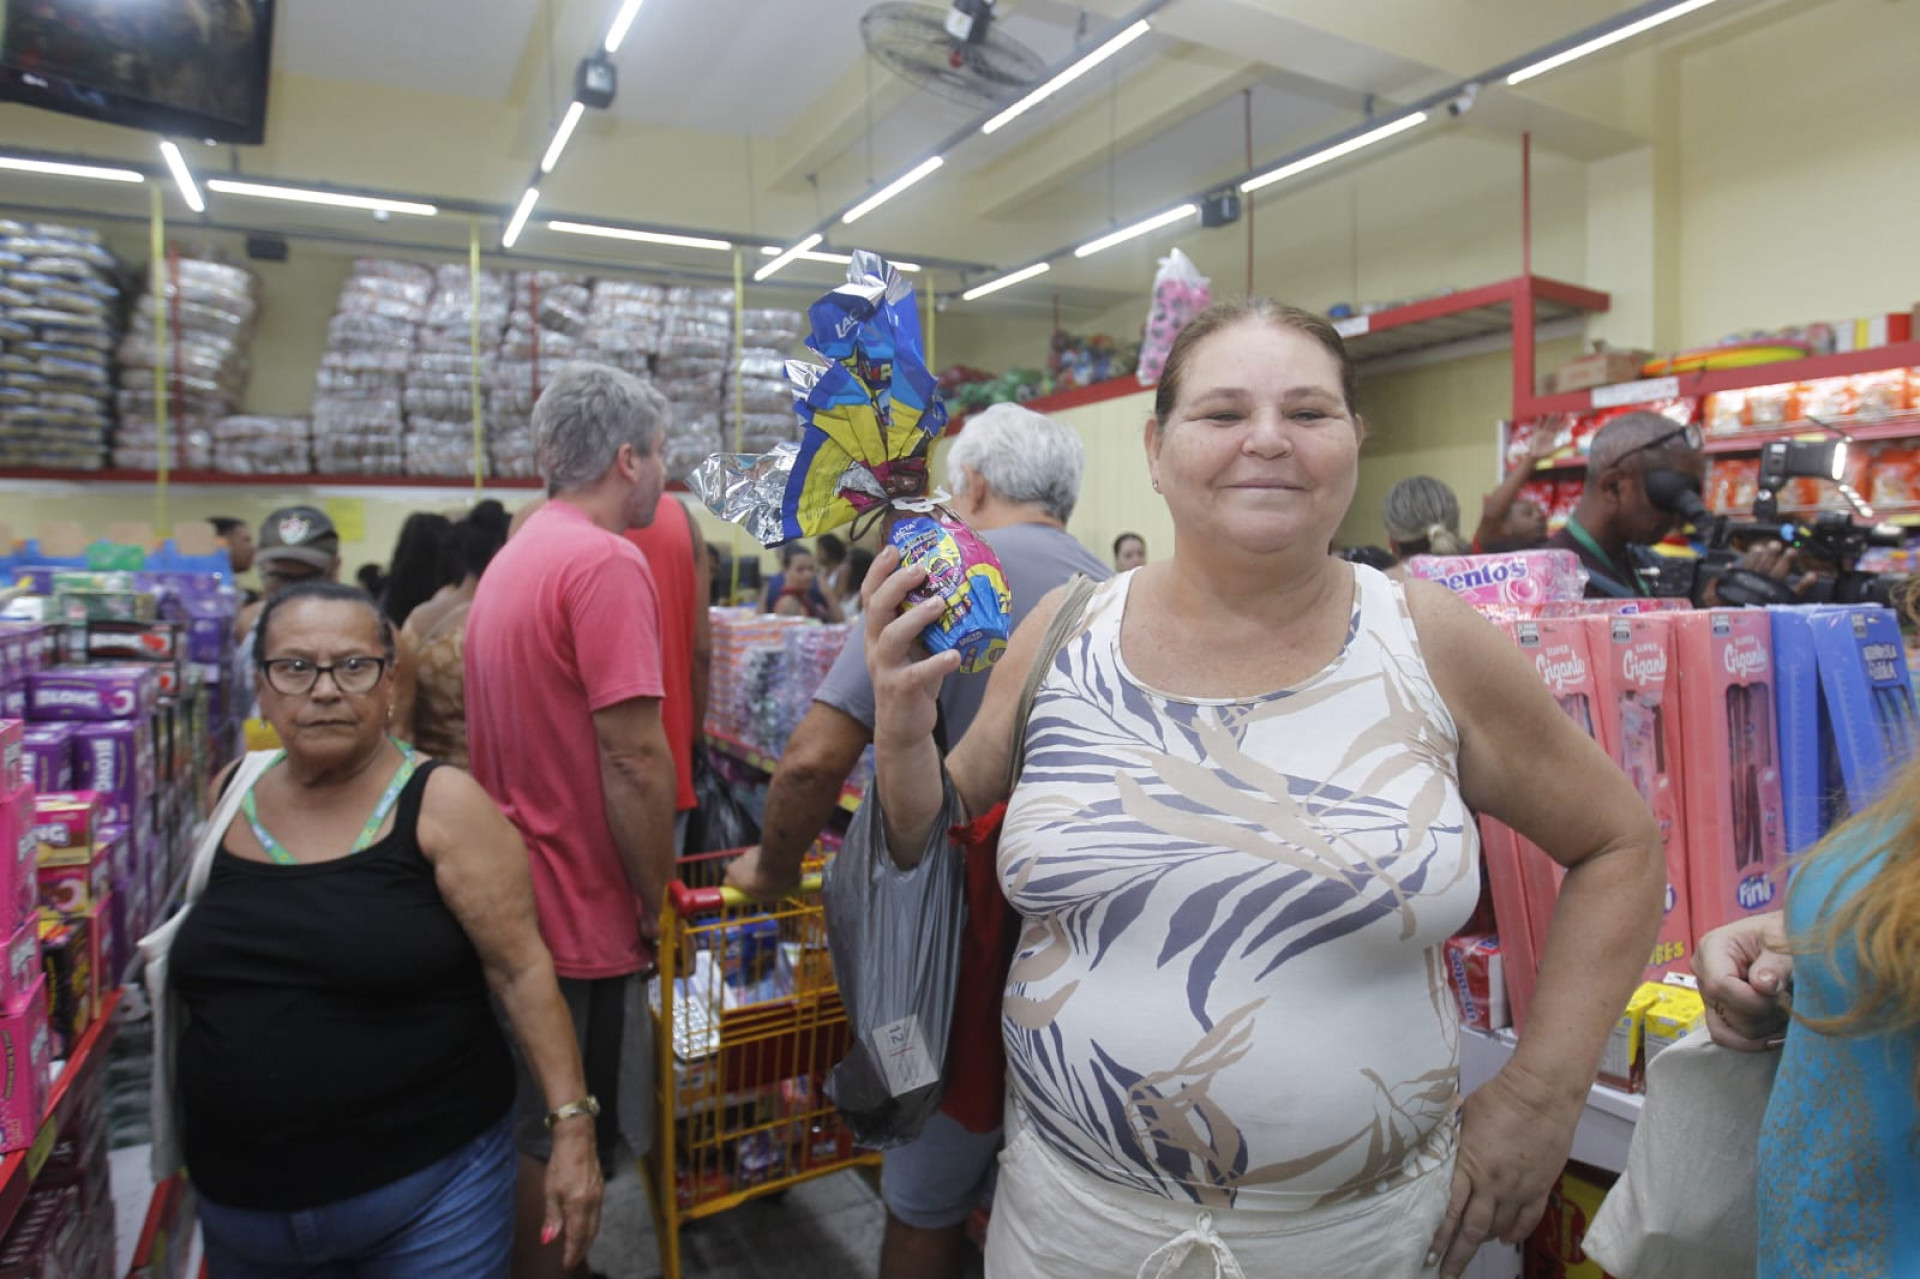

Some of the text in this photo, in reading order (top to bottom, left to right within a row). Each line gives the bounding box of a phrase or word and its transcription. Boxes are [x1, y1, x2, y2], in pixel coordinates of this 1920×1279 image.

[892, 521, 916, 541] LACTA
[1623, 648, 1667, 685] Gigant
[1738, 875, 1771, 907] Fini
